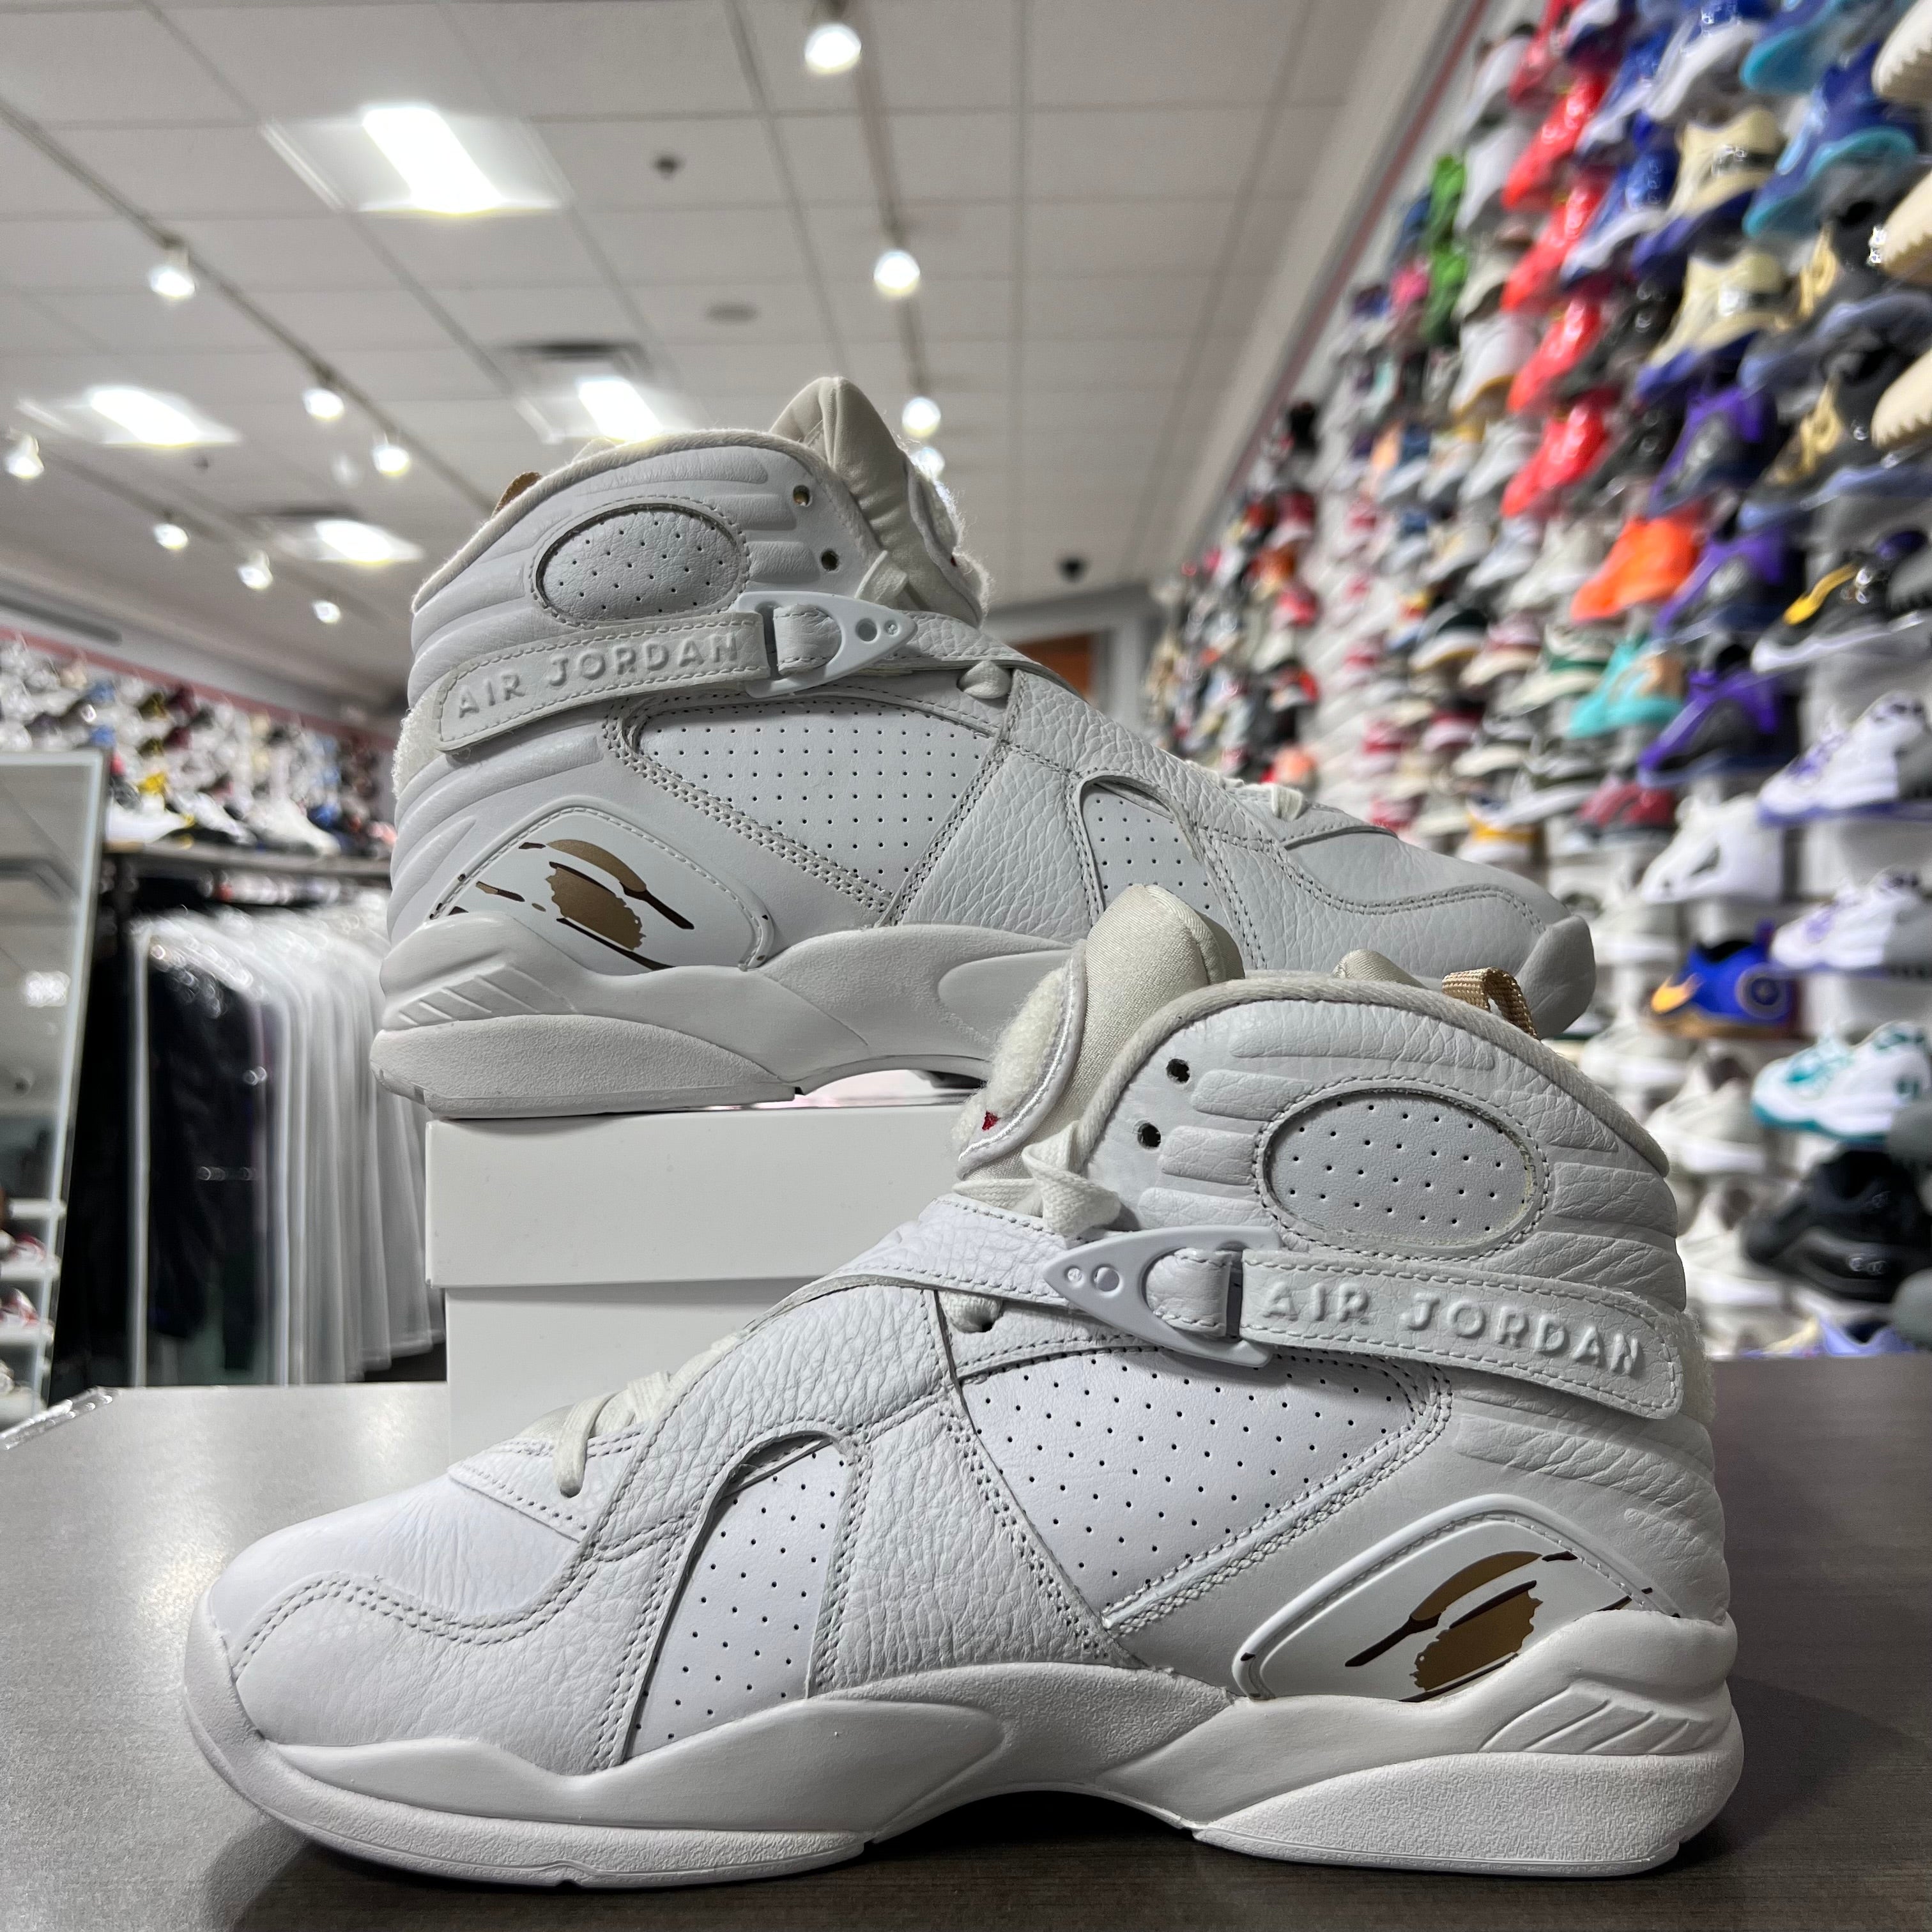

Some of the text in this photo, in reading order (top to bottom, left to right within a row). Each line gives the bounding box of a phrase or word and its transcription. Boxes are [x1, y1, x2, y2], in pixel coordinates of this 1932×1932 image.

[457, 632, 738, 718] AIR JORDAN
[1264, 1281, 1639, 1376] AIR JORDAN
